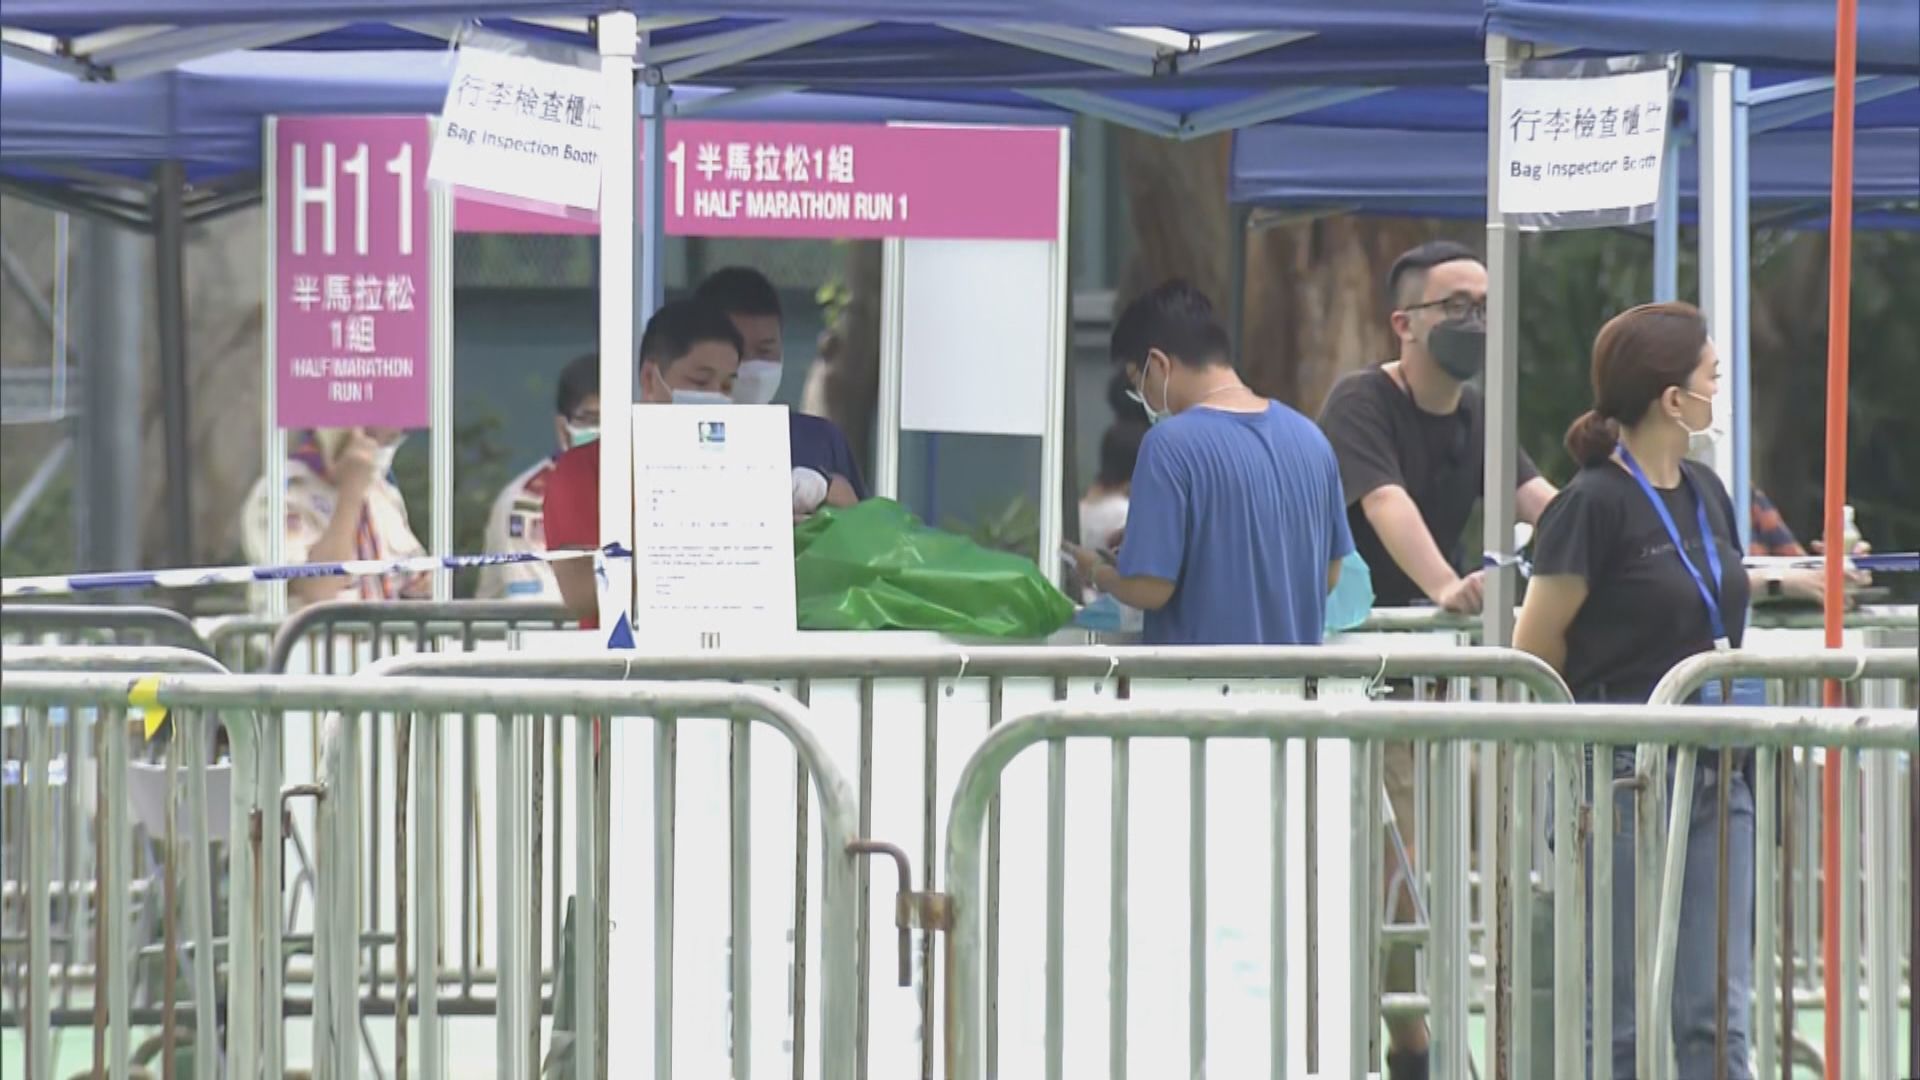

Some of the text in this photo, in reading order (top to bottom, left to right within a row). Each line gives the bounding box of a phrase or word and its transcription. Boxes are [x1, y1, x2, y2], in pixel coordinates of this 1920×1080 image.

[447, 122, 477, 145] Bag
[482, 130, 559, 158] Inspection
[696, 143, 855, 183] 半馬拉松1組
[1510, 161, 1542, 181] Bag
[1547, 160, 1618, 179] Inspection
[292, 142, 413, 255] H11
[694, 191, 908, 221] HALF MARATHON RUN 1
[290, 273, 416, 312] 半馬拉松
[330, 315, 376, 352] 1組
[291, 357, 413, 378] HALF MARATHON
[329, 381, 374, 402] RUN 1
